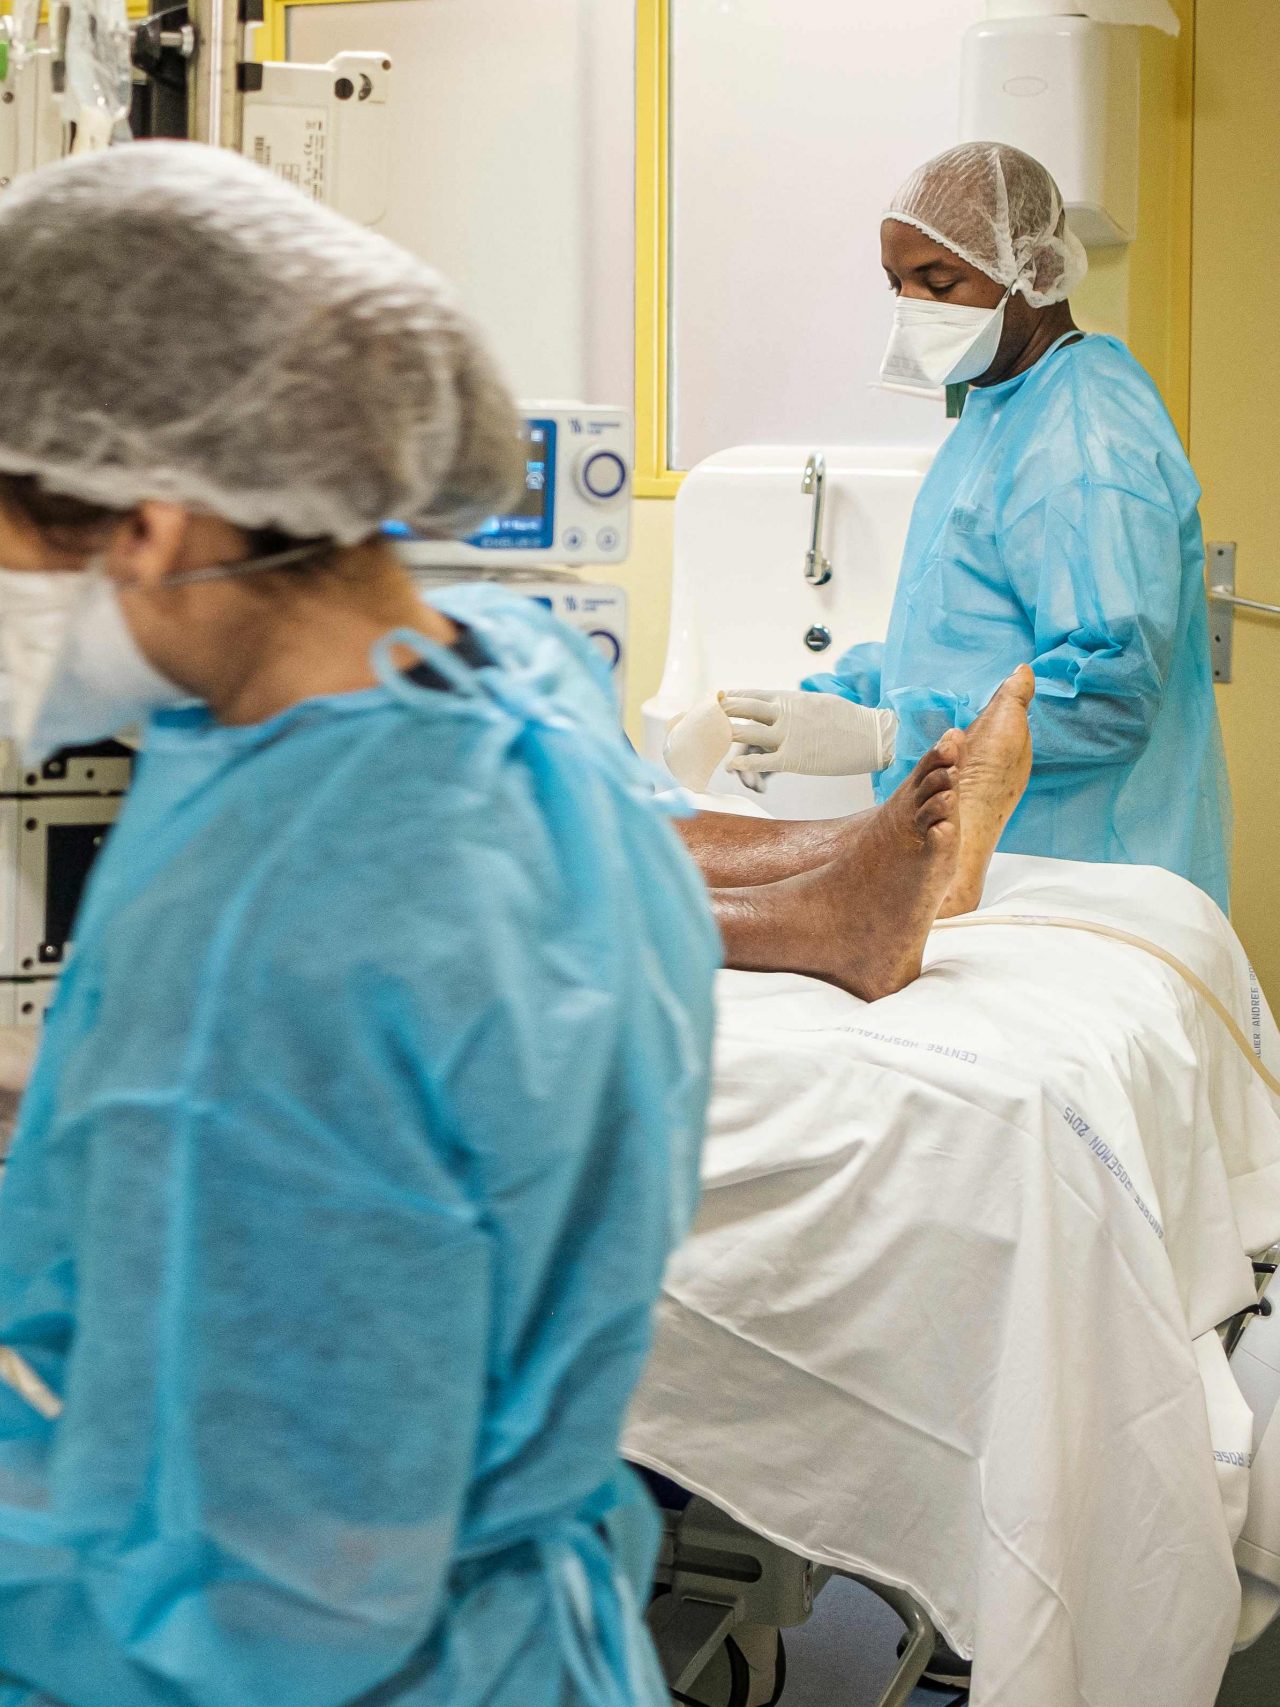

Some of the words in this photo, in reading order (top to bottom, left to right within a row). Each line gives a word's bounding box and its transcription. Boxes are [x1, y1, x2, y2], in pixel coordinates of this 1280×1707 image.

[1250, 987, 1261, 1027] ANDREE
[926, 1042, 978, 1064] CENTRE
[1063, 1106, 1090, 1137] 2015
[1088, 1134, 1133, 1192] ROSEMON
[1213, 1450, 1245, 1467] ROSE
